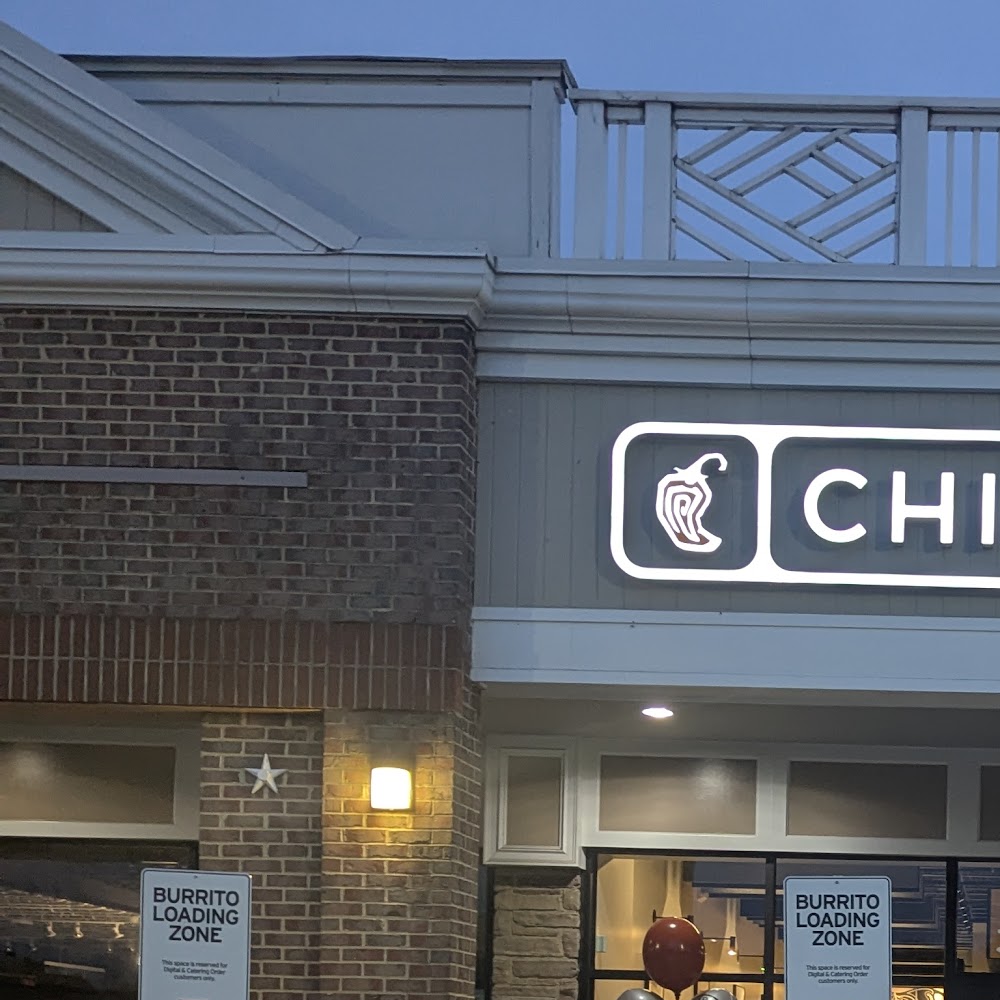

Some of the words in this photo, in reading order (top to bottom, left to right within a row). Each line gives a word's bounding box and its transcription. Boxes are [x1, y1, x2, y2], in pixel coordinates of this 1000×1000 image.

[153, 887, 239, 906] BURRITO
[796, 894, 880, 910] BURRITO
[153, 905, 239, 925] LOADING
[796, 912, 880, 928] LOADING
[169, 925, 222, 943] ZONE
[812, 931, 864, 946] ZONE
[187, 967, 210, 975] Catering
